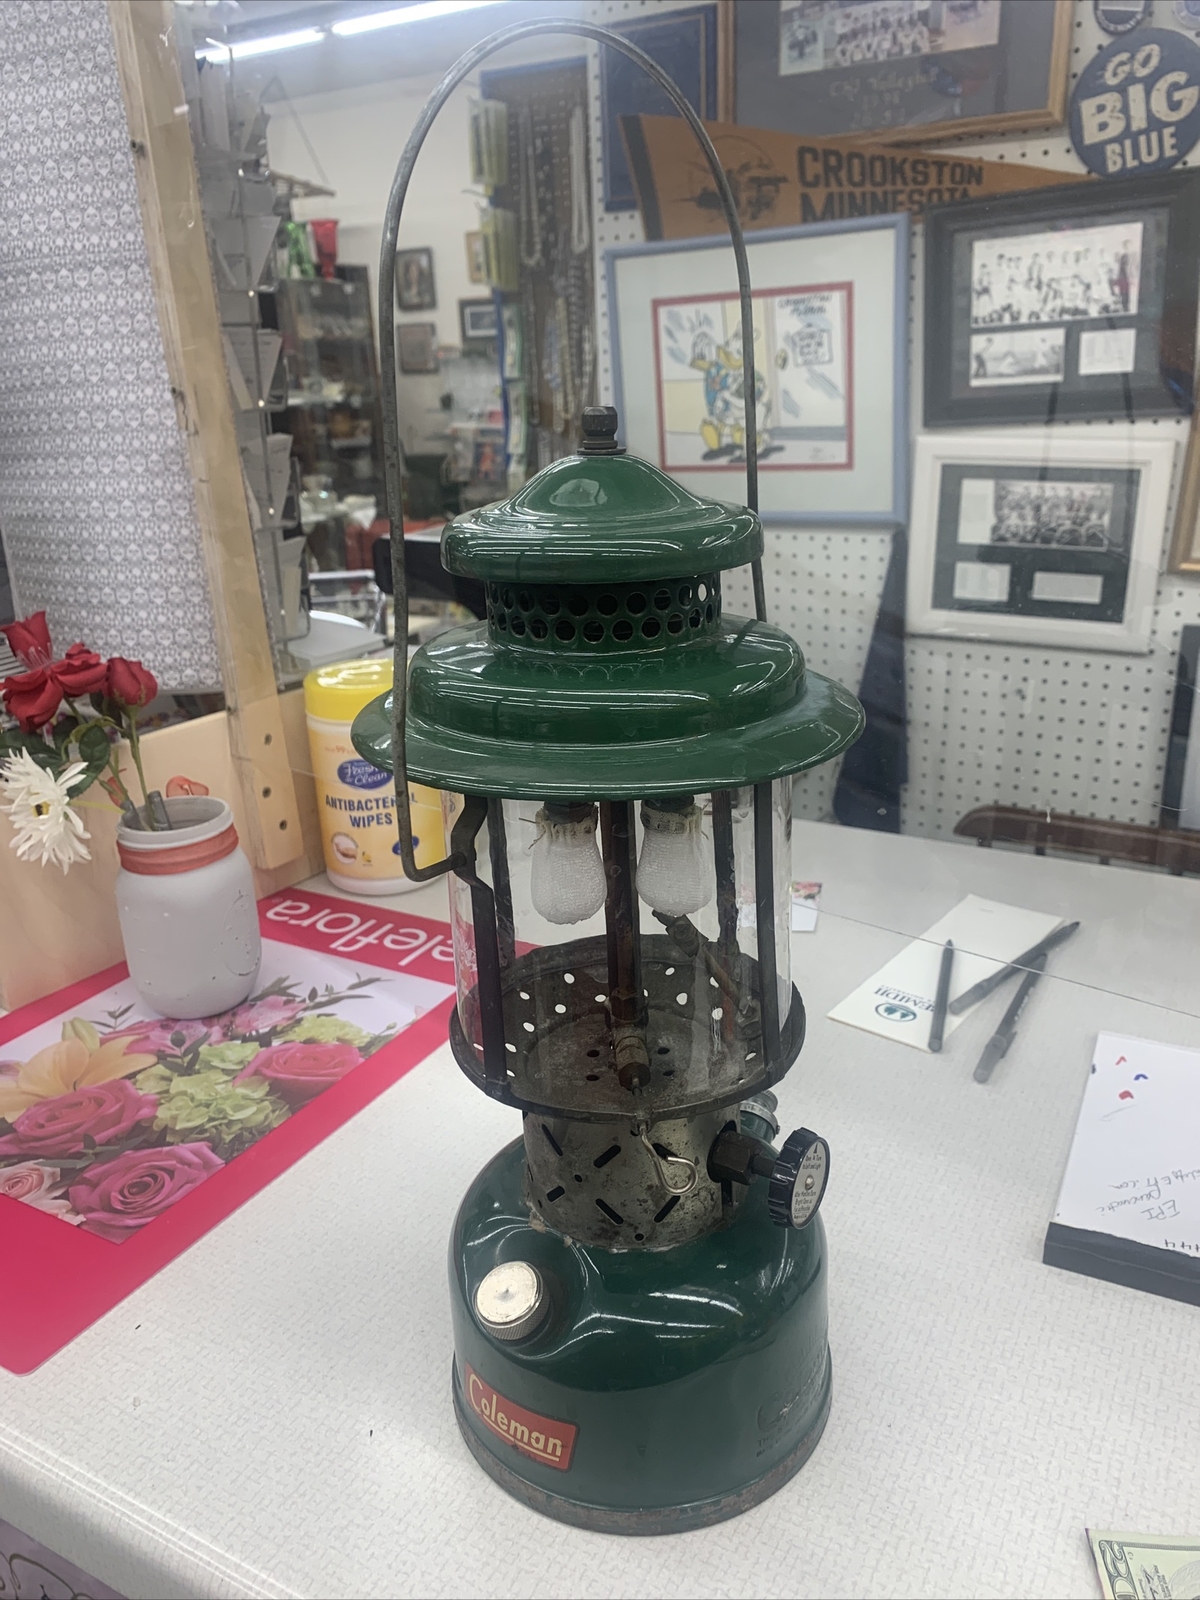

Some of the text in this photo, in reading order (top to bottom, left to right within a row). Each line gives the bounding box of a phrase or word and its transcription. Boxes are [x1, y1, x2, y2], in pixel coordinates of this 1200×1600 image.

[1104, 43, 1161, 86] GO
[1079, 71, 1200, 145] BIG
[797, 146, 984, 188] CROOKSTON
[1104, 126, 1178, 173] BLUE
[354, 771, 388, 786] Clean
[349, 812, 393, 828] WIPES
[266, 899, 456, 967] eleflora
[1141, 1200, 1180, 1221] EPI
[469, 1373, 563, 1457] Coleman
